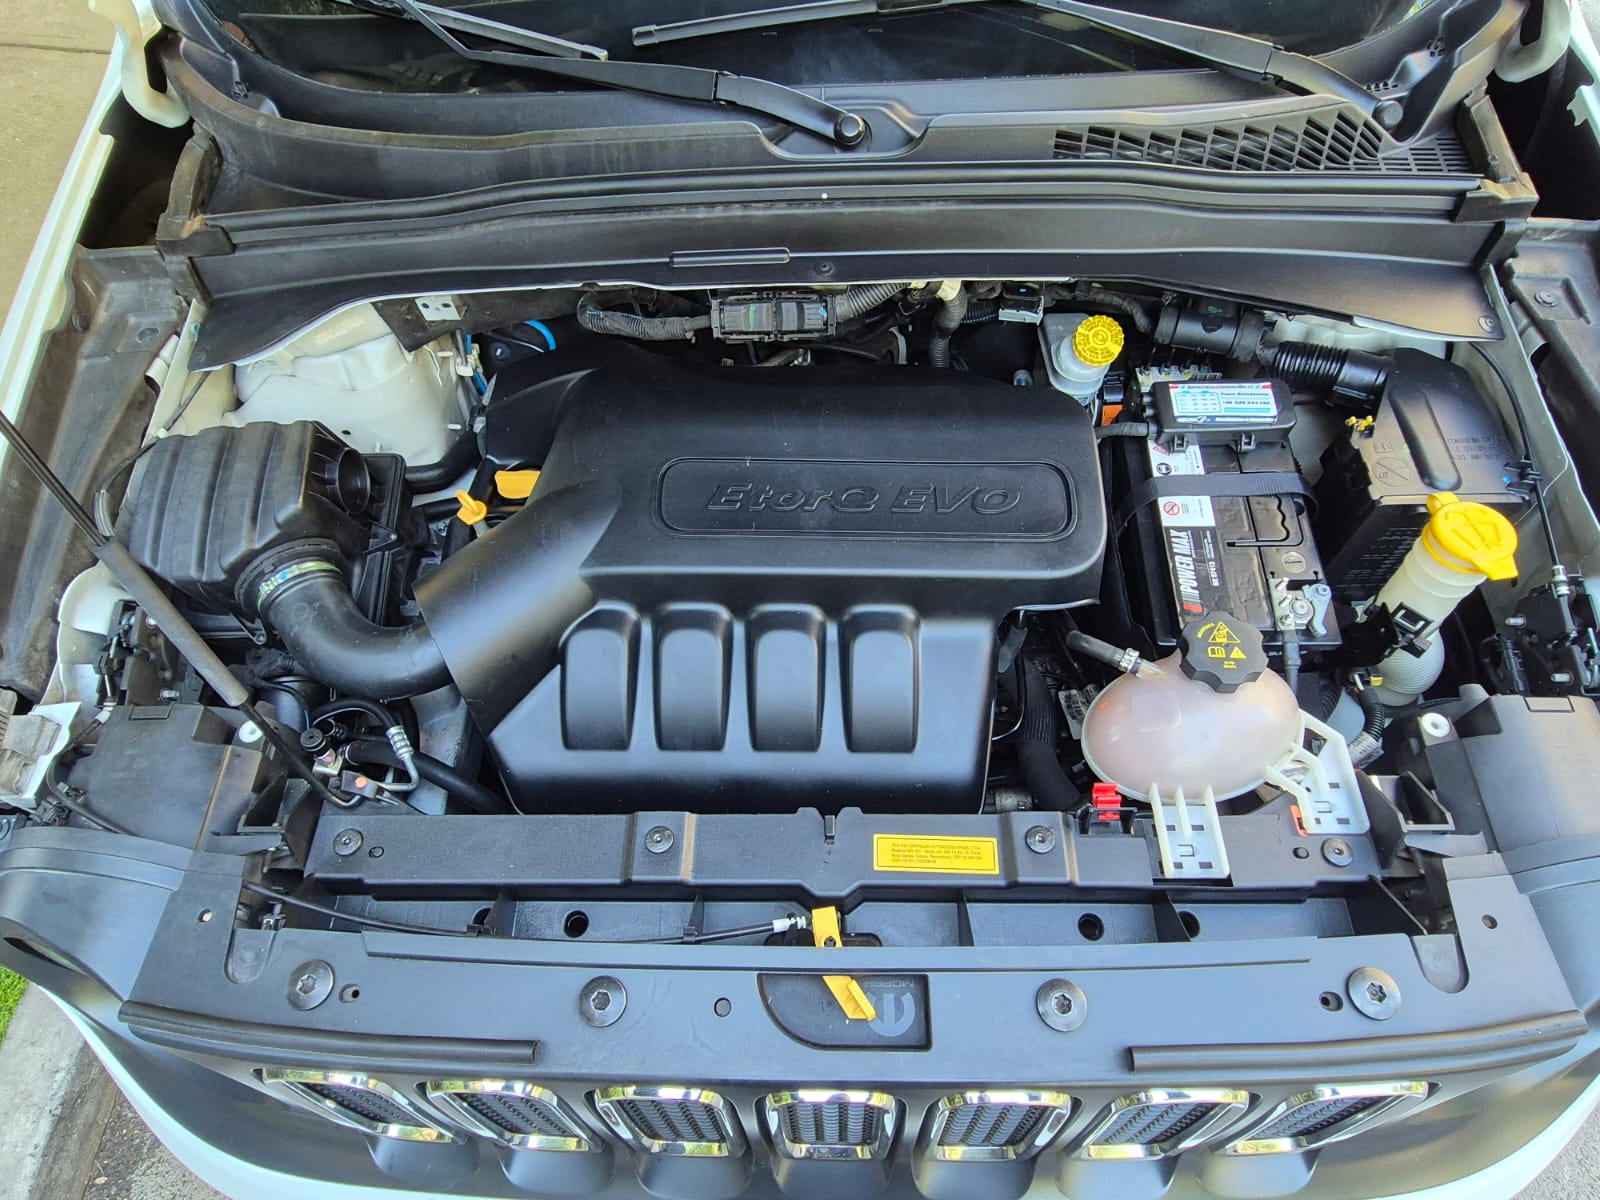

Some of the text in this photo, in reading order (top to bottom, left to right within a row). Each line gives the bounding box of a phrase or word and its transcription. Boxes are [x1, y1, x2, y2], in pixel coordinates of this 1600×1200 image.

[706, 482, 1021, 514] EtorQ EVO
[1169, 529, 1192, 555] MAX
[1174, 555, 1199, 594] POWER
